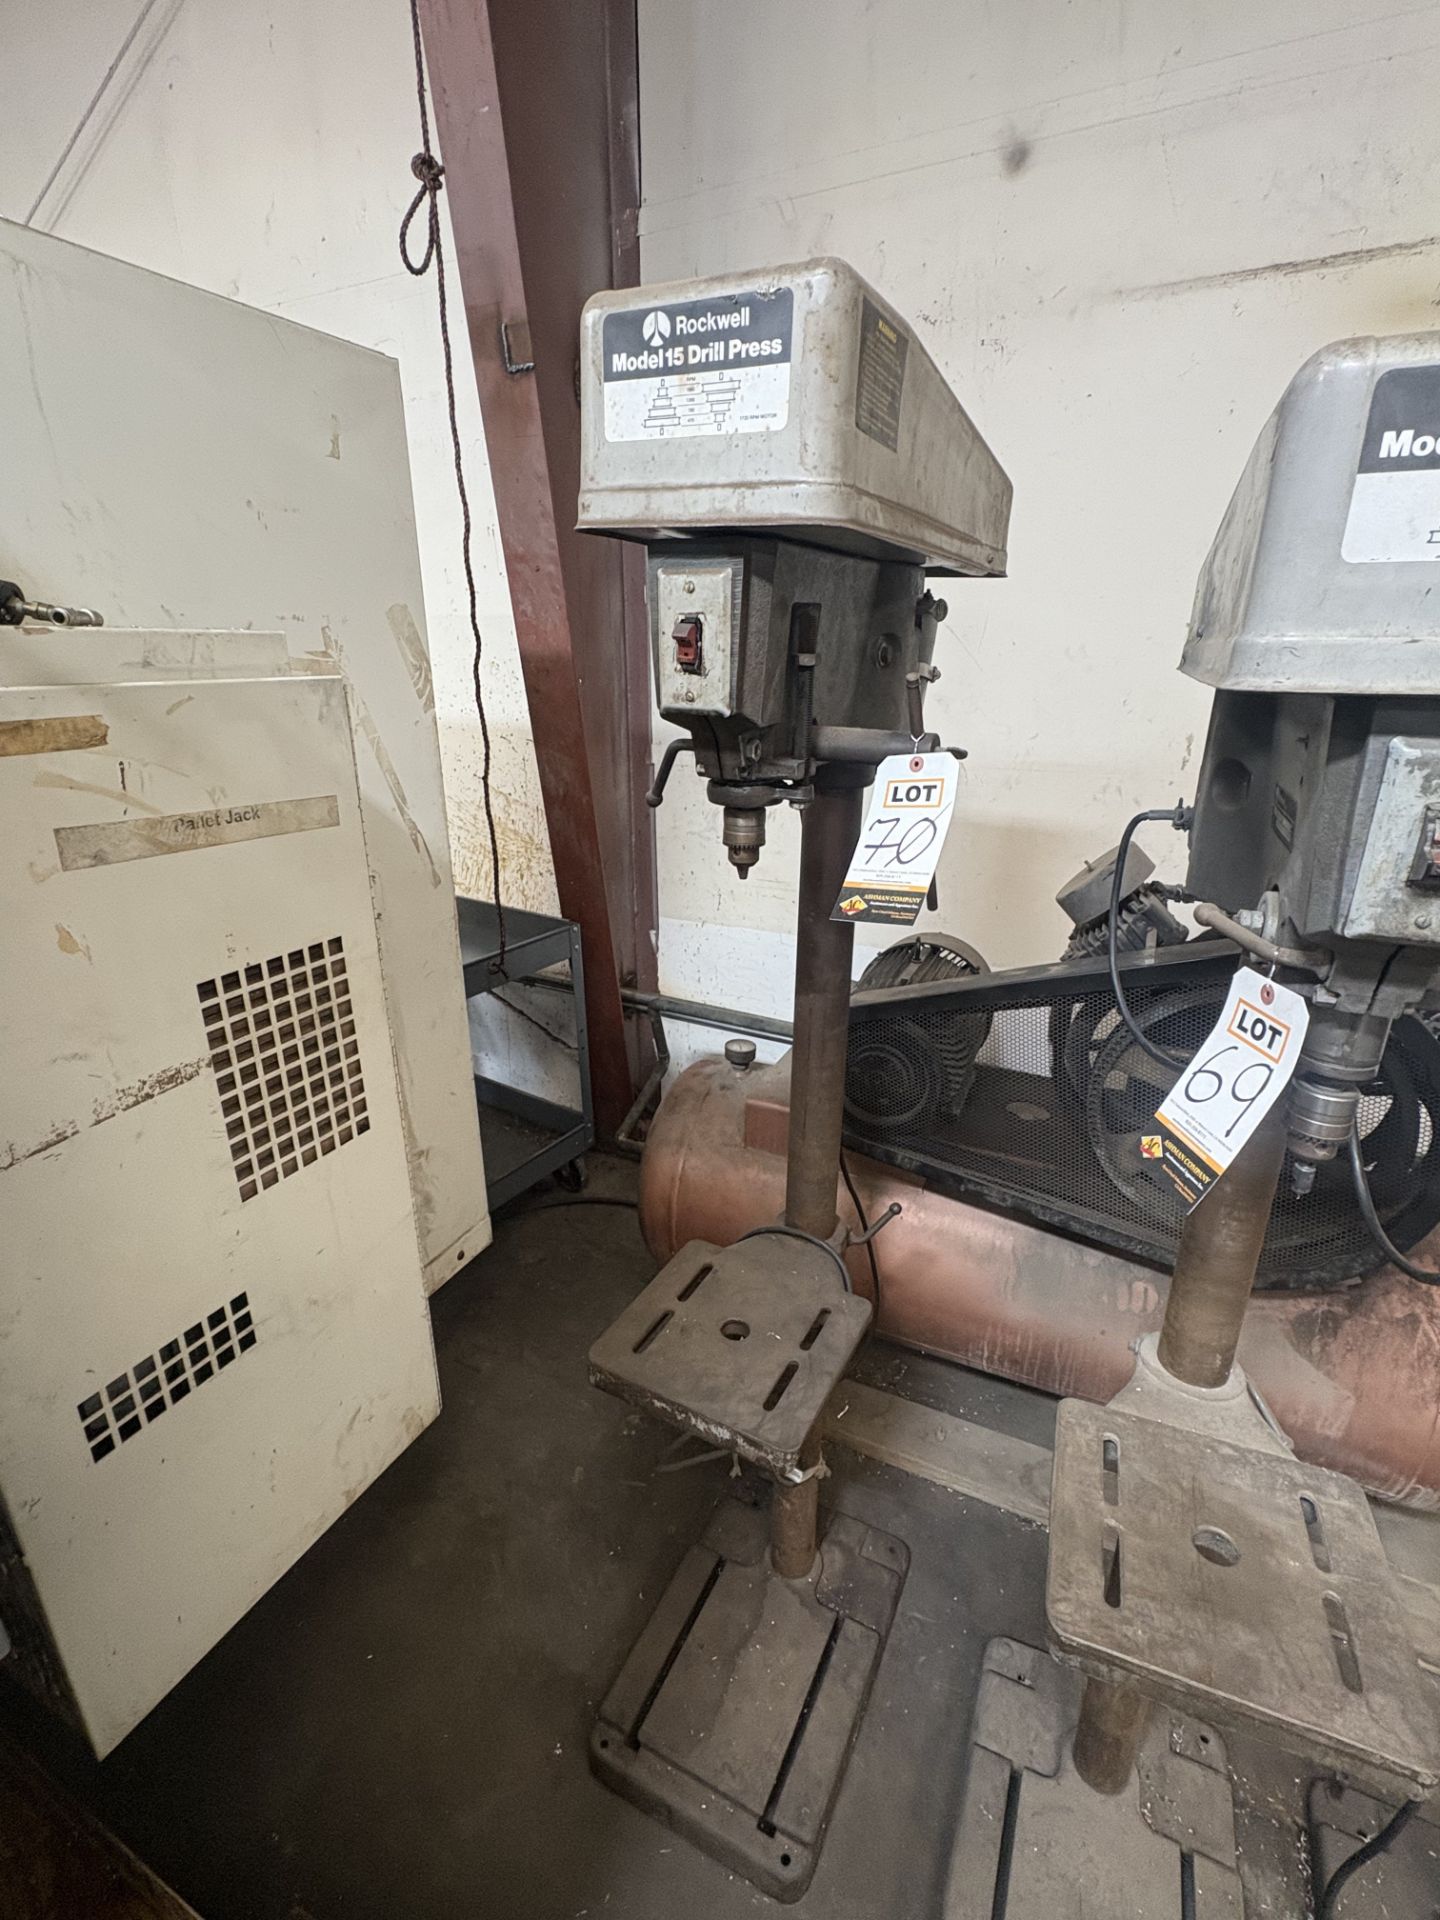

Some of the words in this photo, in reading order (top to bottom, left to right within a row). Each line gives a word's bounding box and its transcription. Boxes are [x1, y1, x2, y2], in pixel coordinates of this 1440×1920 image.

[675, 307, 750, 336] Rockwell
[612, 347, 664, 373] Model
[665, 347, 684, 367] 15
[688, 343, 725, 364] Drill
[728, 338, 783, 360] Press
[891, 785, 937, 803] LOT
[224, 806, 261, 825] Jack
[864, 806, 946, 868] 70
[889, 895, 922, 904] COMPANY
[1237, 1009, 1282, 1050] LOT
[1184, 1046, 1274, 1138] 69
[1183, 1156, 1212, 1184] COMPANY
